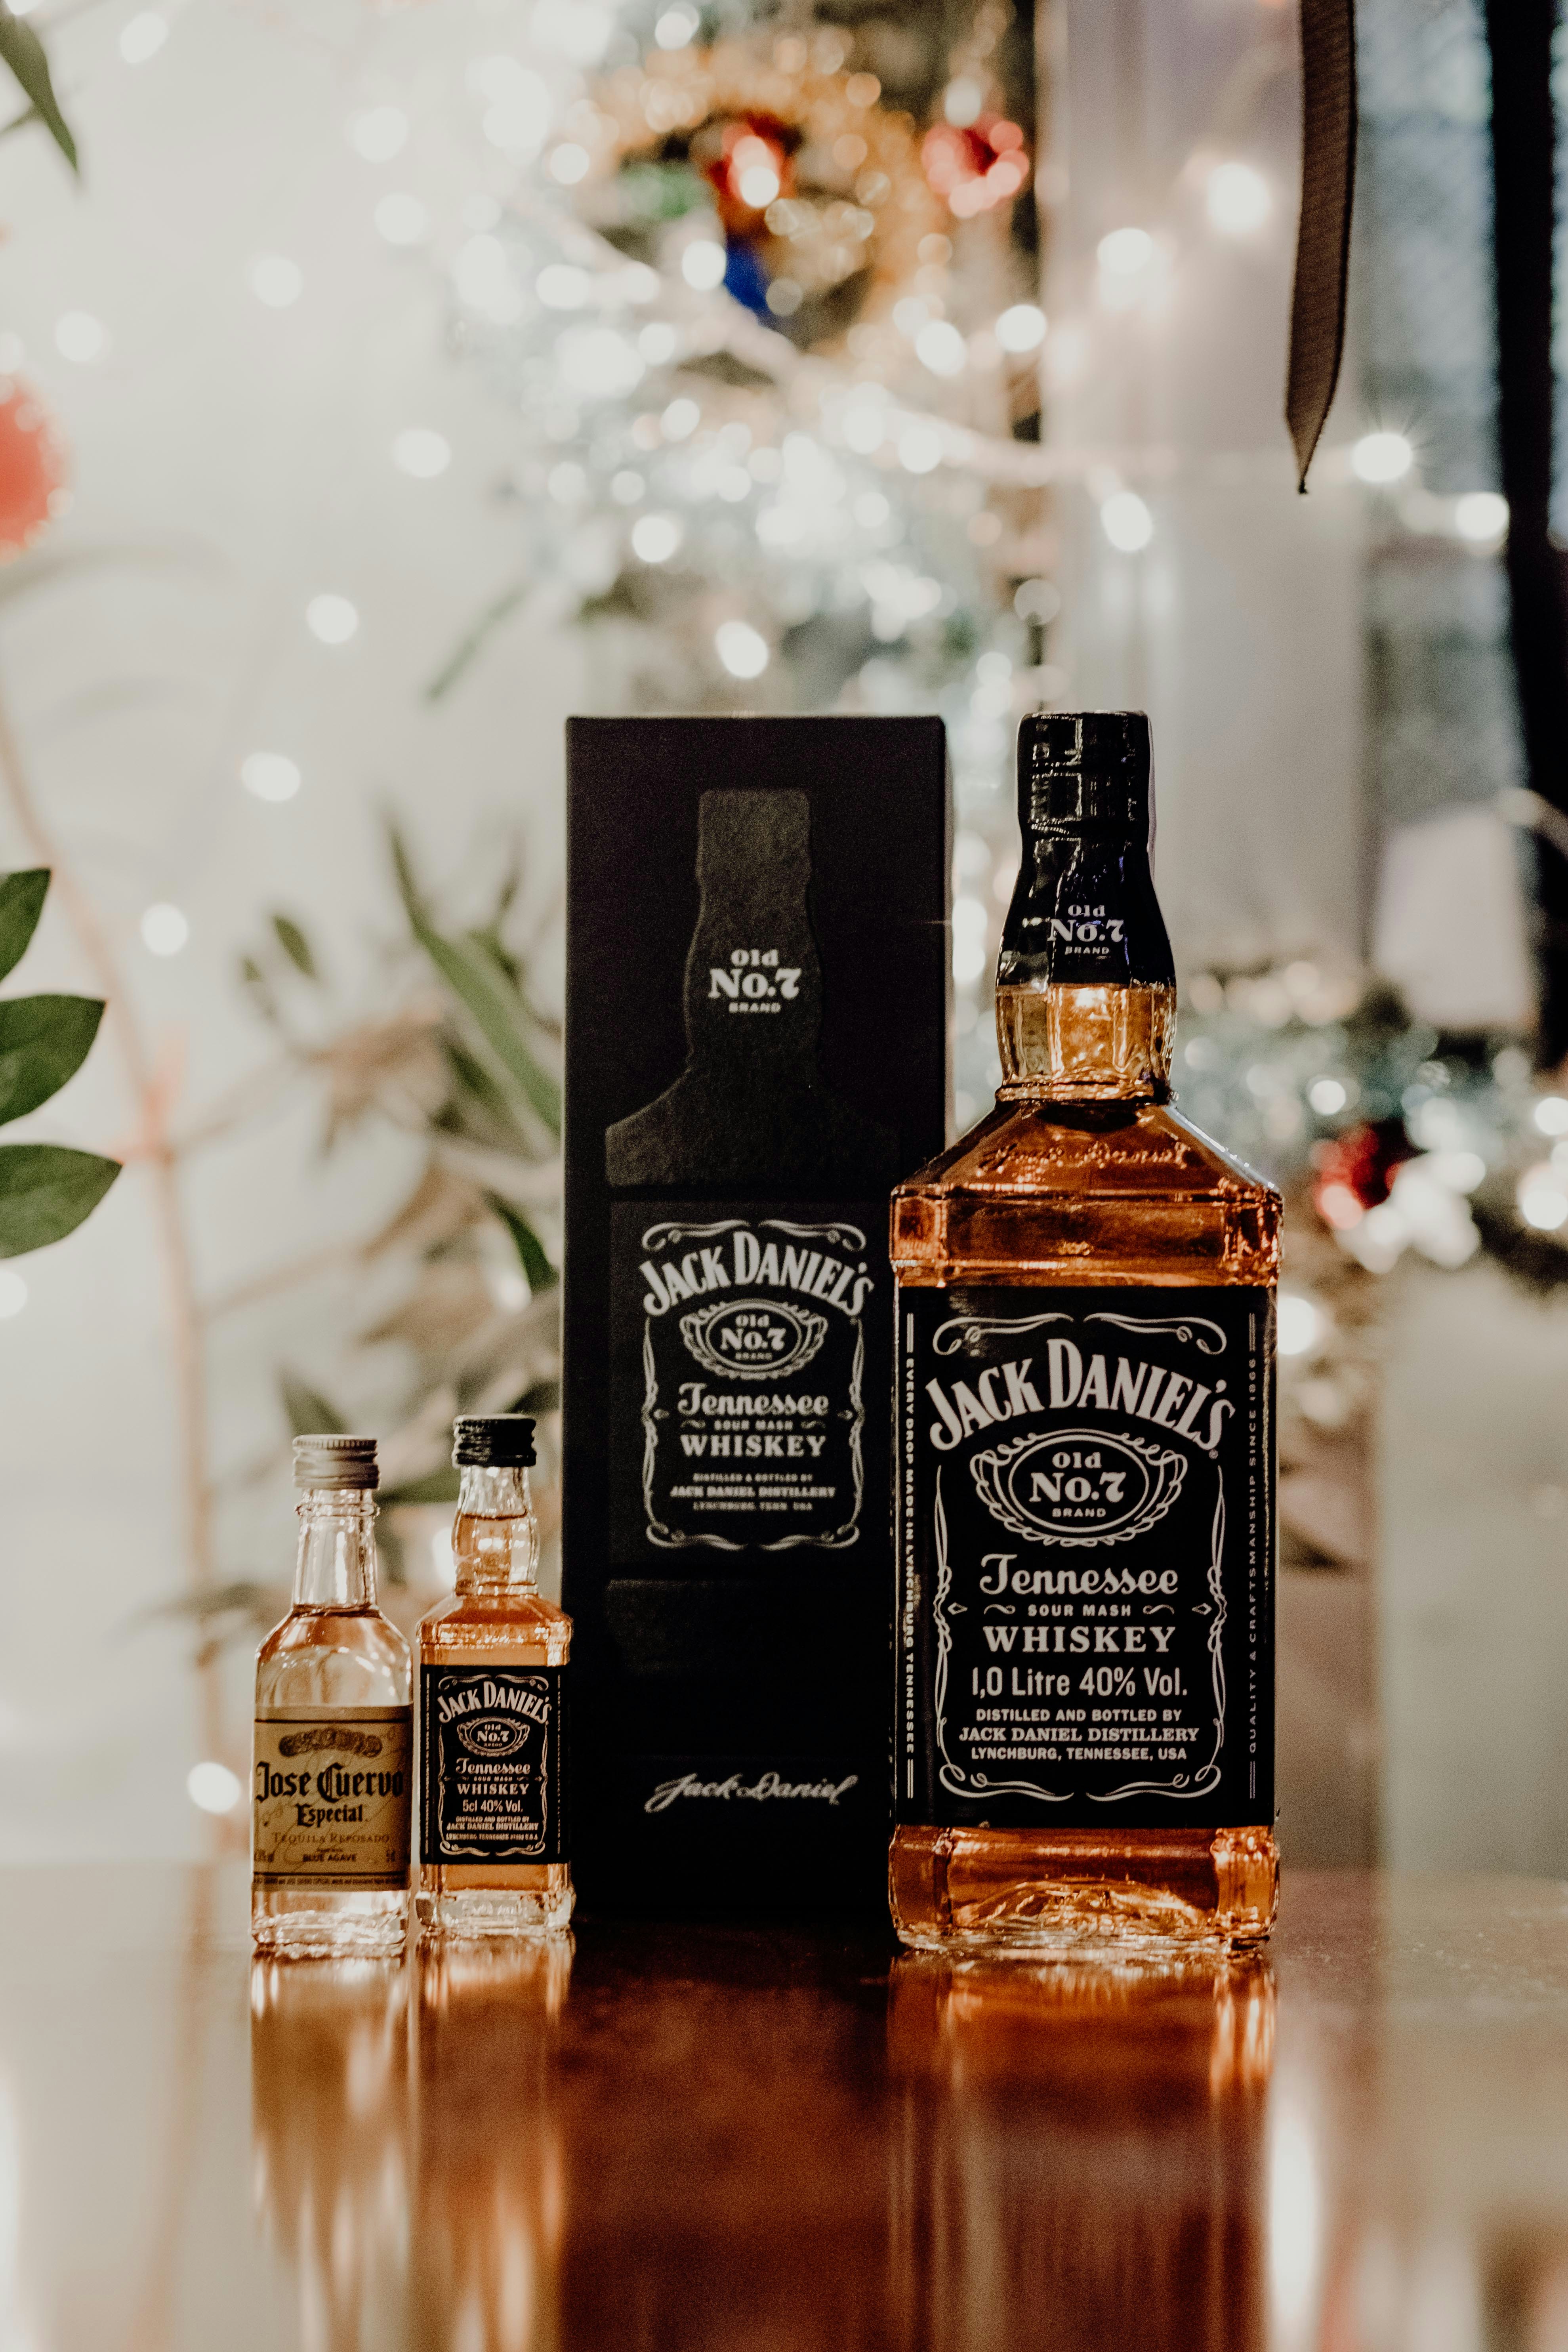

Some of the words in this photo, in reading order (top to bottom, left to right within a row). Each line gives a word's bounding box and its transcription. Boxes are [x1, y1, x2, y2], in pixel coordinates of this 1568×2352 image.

[1067, 904, 1106, 917] Old
[1047, 919, 1124, 942] No.7
[731, 949, 779, 967] Old
[1064, 946, 1110, 955] BRAND
[708, 968, 801, 1000] No.7
[639, 1245, 731, 1316] JACK
[734, 1231, 874, 1316] DANIEL'S
[735, 1314, 769, 1328] Old
[720, 1328, 786, 1351] No.7
[906, 1358, 914, 1414] EVERY
[925, 1358, 1045, 1451] JACK
[1046, 1338, 1237, 1451] DANIEL'S
[677, 1382, 829, 1416] Tennessee
[680, 1434, 826, 1457] WHISKEY
[906, 1418, 914, 1465] DROP
[1052, 1452, 1102, 1469] Old
[906, 1469, 914, 1517] MADE
[1029, 1472, 1125, 1503] No.7
[1052, 1508, 1106, 1518] BRAND
[906, 1522, 914, 1540] IN
[979, 1553, 1178, 1595] Tennessee
[1028, 1604, 1074, 1617] SOUR
[1082, 1604, 1131, 1617] MASH
[982, 1626, 1175, 1653] WHISKEY
[1249, 1651, 1256, 1661] &
[972, 1666, 1003, 1699] 1,0
[1012, 1667, 1070, 1696] Litre
[1079, 1667, 1136, 1696] 40%
[1143, 1667, 1187, 1696] Vol.
[437, 1688, 483, 1723] JACK
[483, 1681, 552, 1724] DANIEL'S
[906, 1653, 914, 1753] TENNESSEE
[976, 1708, 1050, 1722] DISTILLED
[1055, 1709, 1086, 1721] AND
[1091, 1709, 1157, 1722] BOTTLED
[1162, 1709, 1182, 1722] BY
[477, 1730, 510, 1742] No.7
[959, 1727, 1007, 1741] JACK
[1011, 1727, 1082, 1742] DANIEL
[1088, 1728, 1200, 1742] DISTILLERY
[971, 1747, 1062, 1761] LYNCHBURG,
[1066, 1747, 1153, 1761] TENNESSEE,
[1158, 1747, 1187, 1760] USA
[456, 1758, 530, 1774] Tennessee
[256, 1761, 312, 1803] Jose
[317, 1763, 403, 1803] Cuervo
[457, 1784, 529, 1795] WHISKEY
[643, 1772, 743, 1814] Jack
[736, 1771, 859, 1806] Daniel
[296, 1803, 364, 1827] Especial
[462, 1799, 477, 1812] 5cl
[480, 1799, 503, 1812] 40%
[505, 1800, 523, 1812] Vol.
